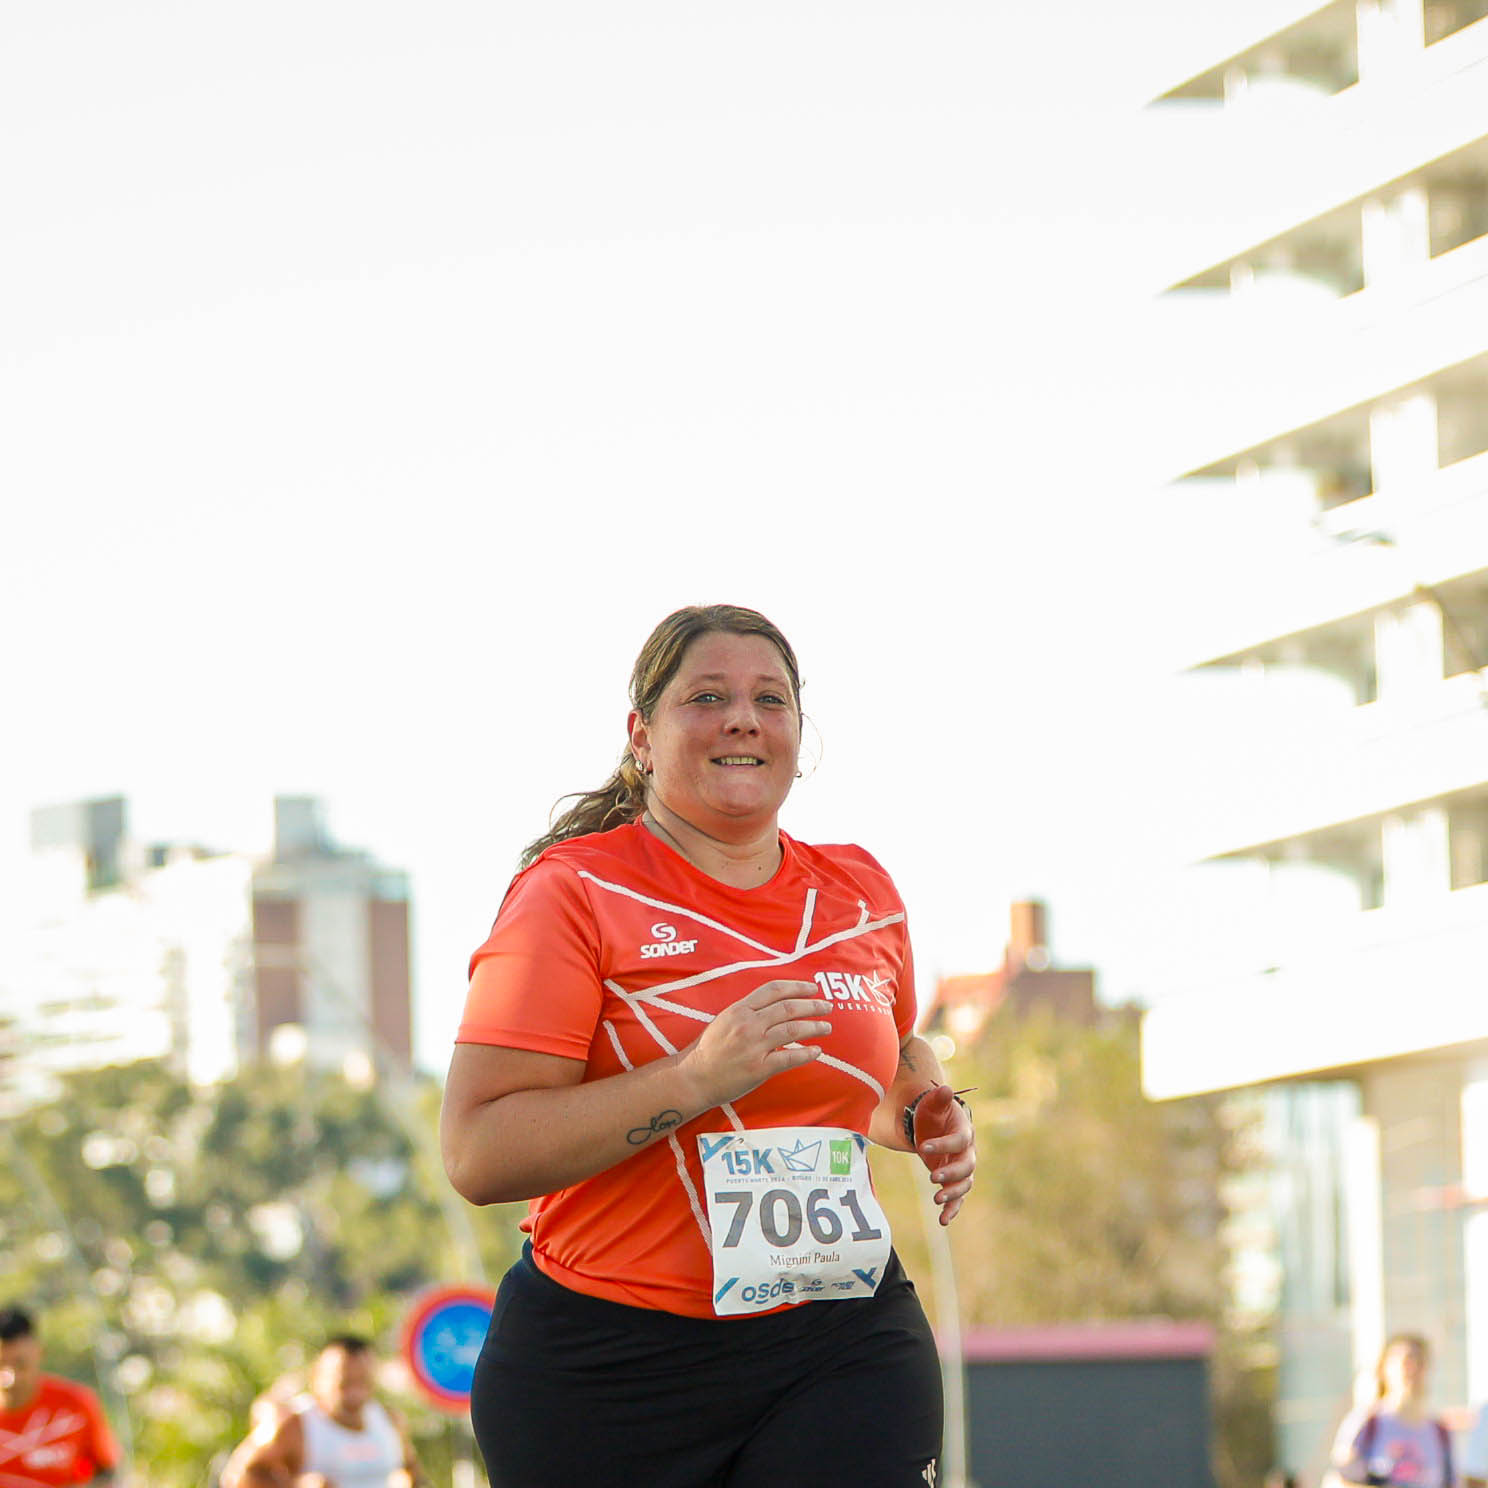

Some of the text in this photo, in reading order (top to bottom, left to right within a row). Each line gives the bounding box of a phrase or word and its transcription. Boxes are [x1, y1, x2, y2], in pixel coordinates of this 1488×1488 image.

[814, 971, 871, 1002] 15K
[830, 1002, 876, 1014] UERTO
[721, 1147, 775, 1175] 15K
[832, 1151, 849, 1165] 10K
[714, 1188, 882, 1248] 7061
[814, 1251, 840, 1264] Paula
[741, 1277, 795, 1302] osde
